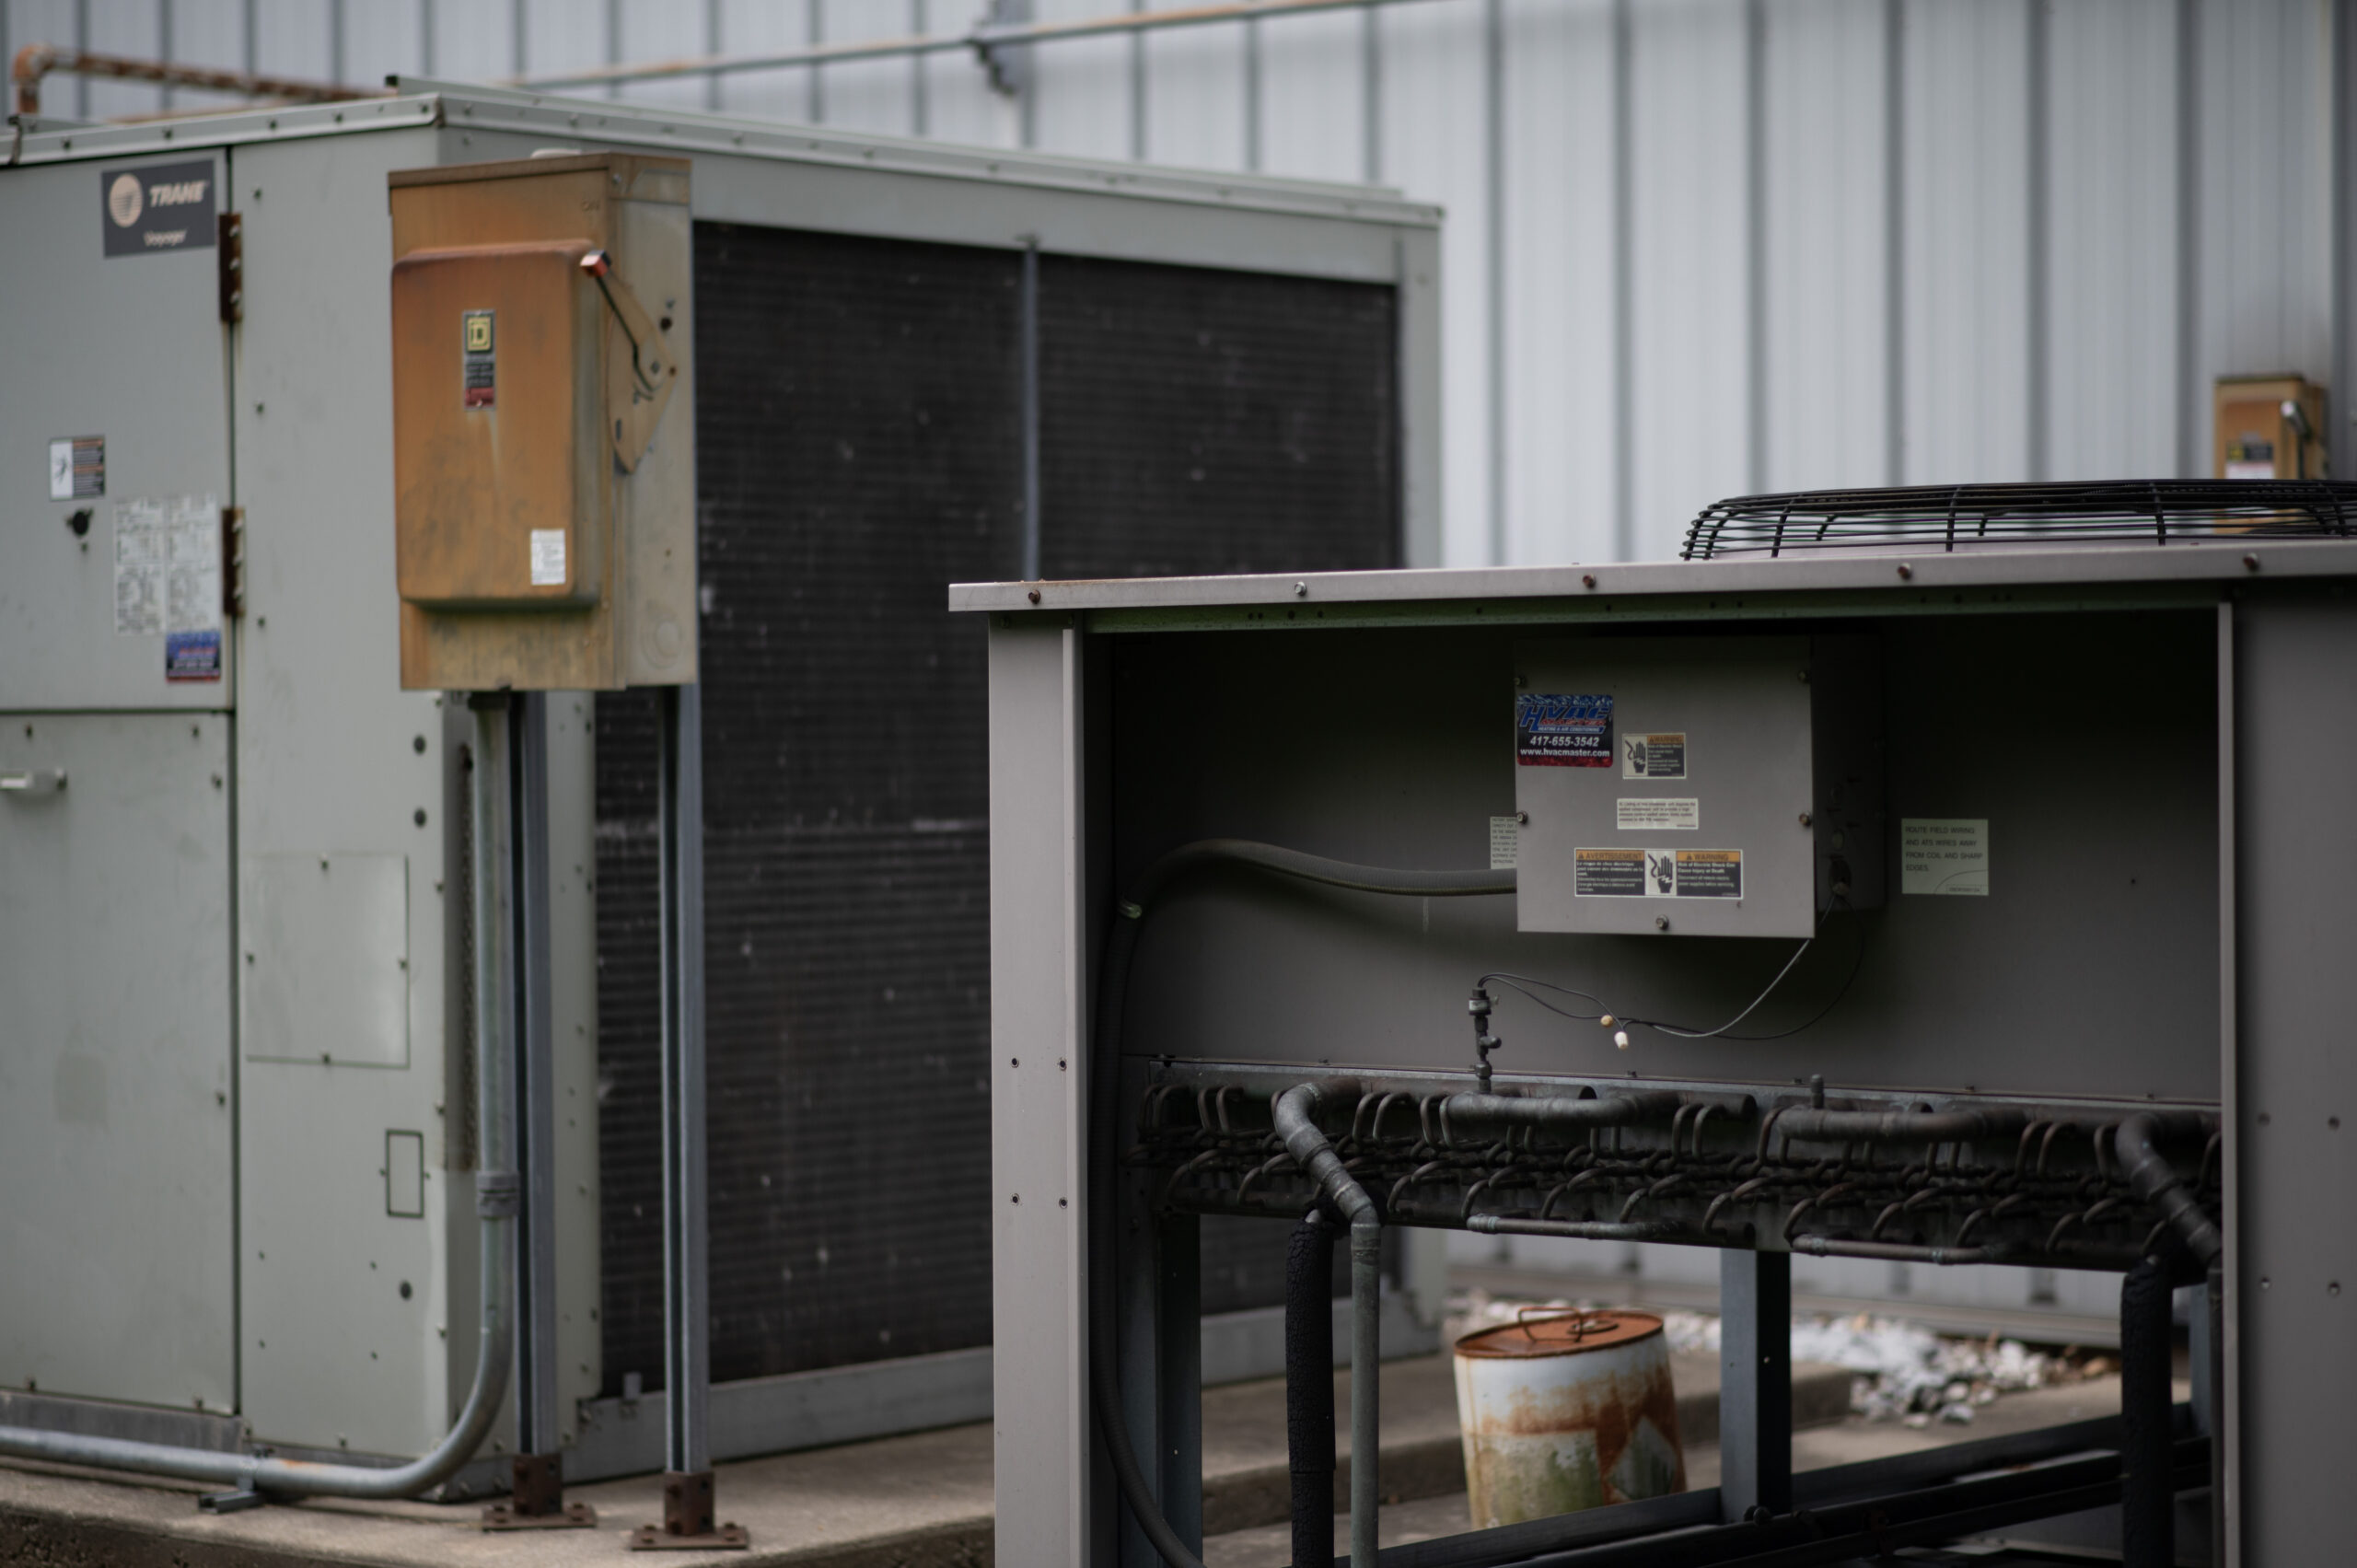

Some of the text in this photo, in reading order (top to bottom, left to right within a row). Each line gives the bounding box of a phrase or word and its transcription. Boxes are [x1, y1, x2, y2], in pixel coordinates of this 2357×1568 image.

[1519, 705, 1609, 733] HVAC
[1529, 736, 1600, 747] 417-655-3542
[1519, 748, 1610, 758] www.hvacmaster.com
[1693, 853, 1729, 861] WARNING
